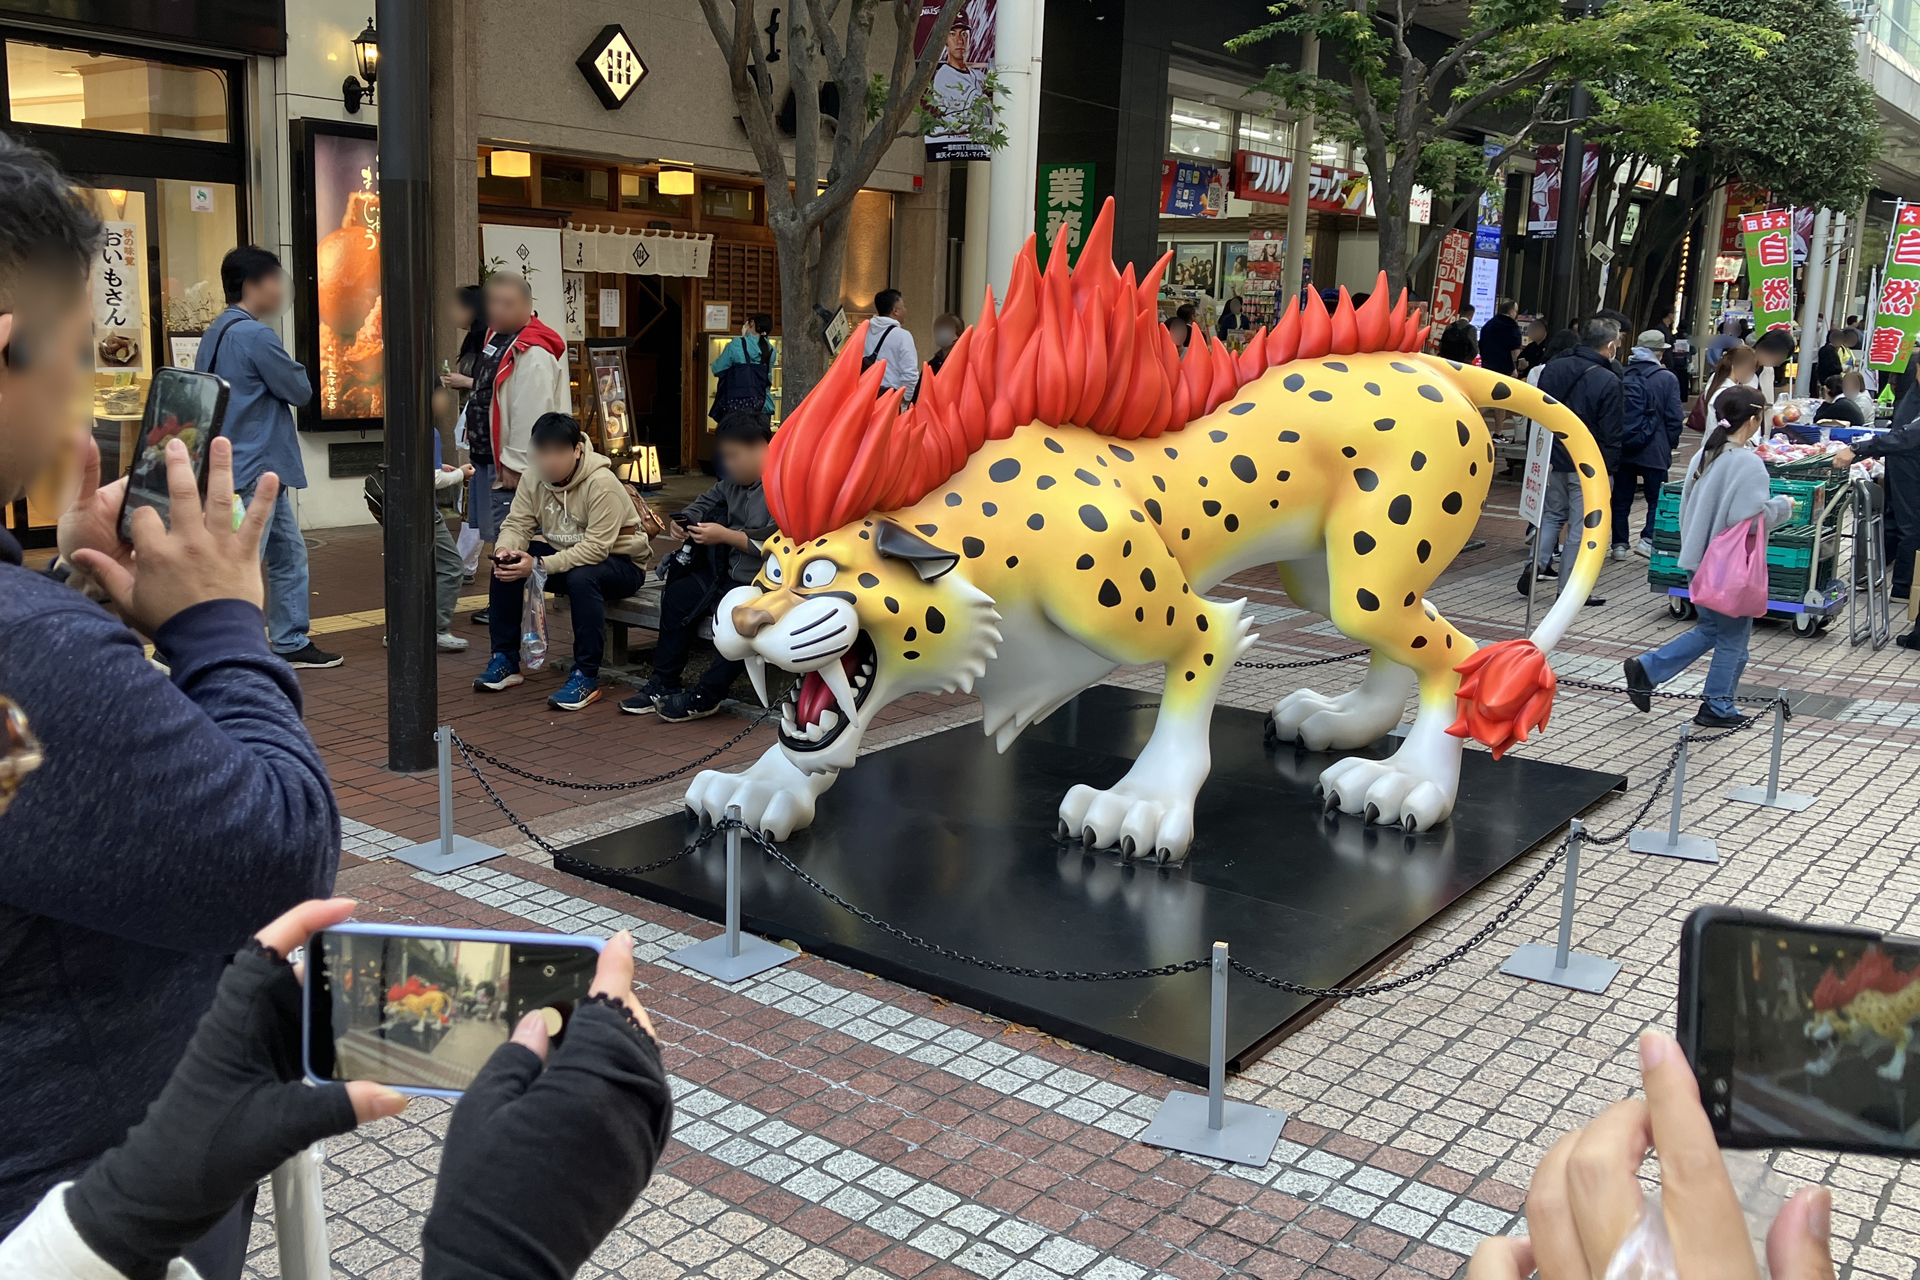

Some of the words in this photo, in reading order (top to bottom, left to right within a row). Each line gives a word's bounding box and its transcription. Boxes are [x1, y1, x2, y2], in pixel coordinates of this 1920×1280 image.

[1046, 167, 1085, 275] 業務
[1420, 209, 1429, 222] 2F
[123, 228, 135, 266] 秋の味覚
[1444, 234, 1470, 249] お客様
[1442, 248, 1467, 267] 感謝
[102, 228, 126, 326] おいもさん
[1440, 264, 1464, 283] DAY
[1434, 280, 1456, 323] 5%
